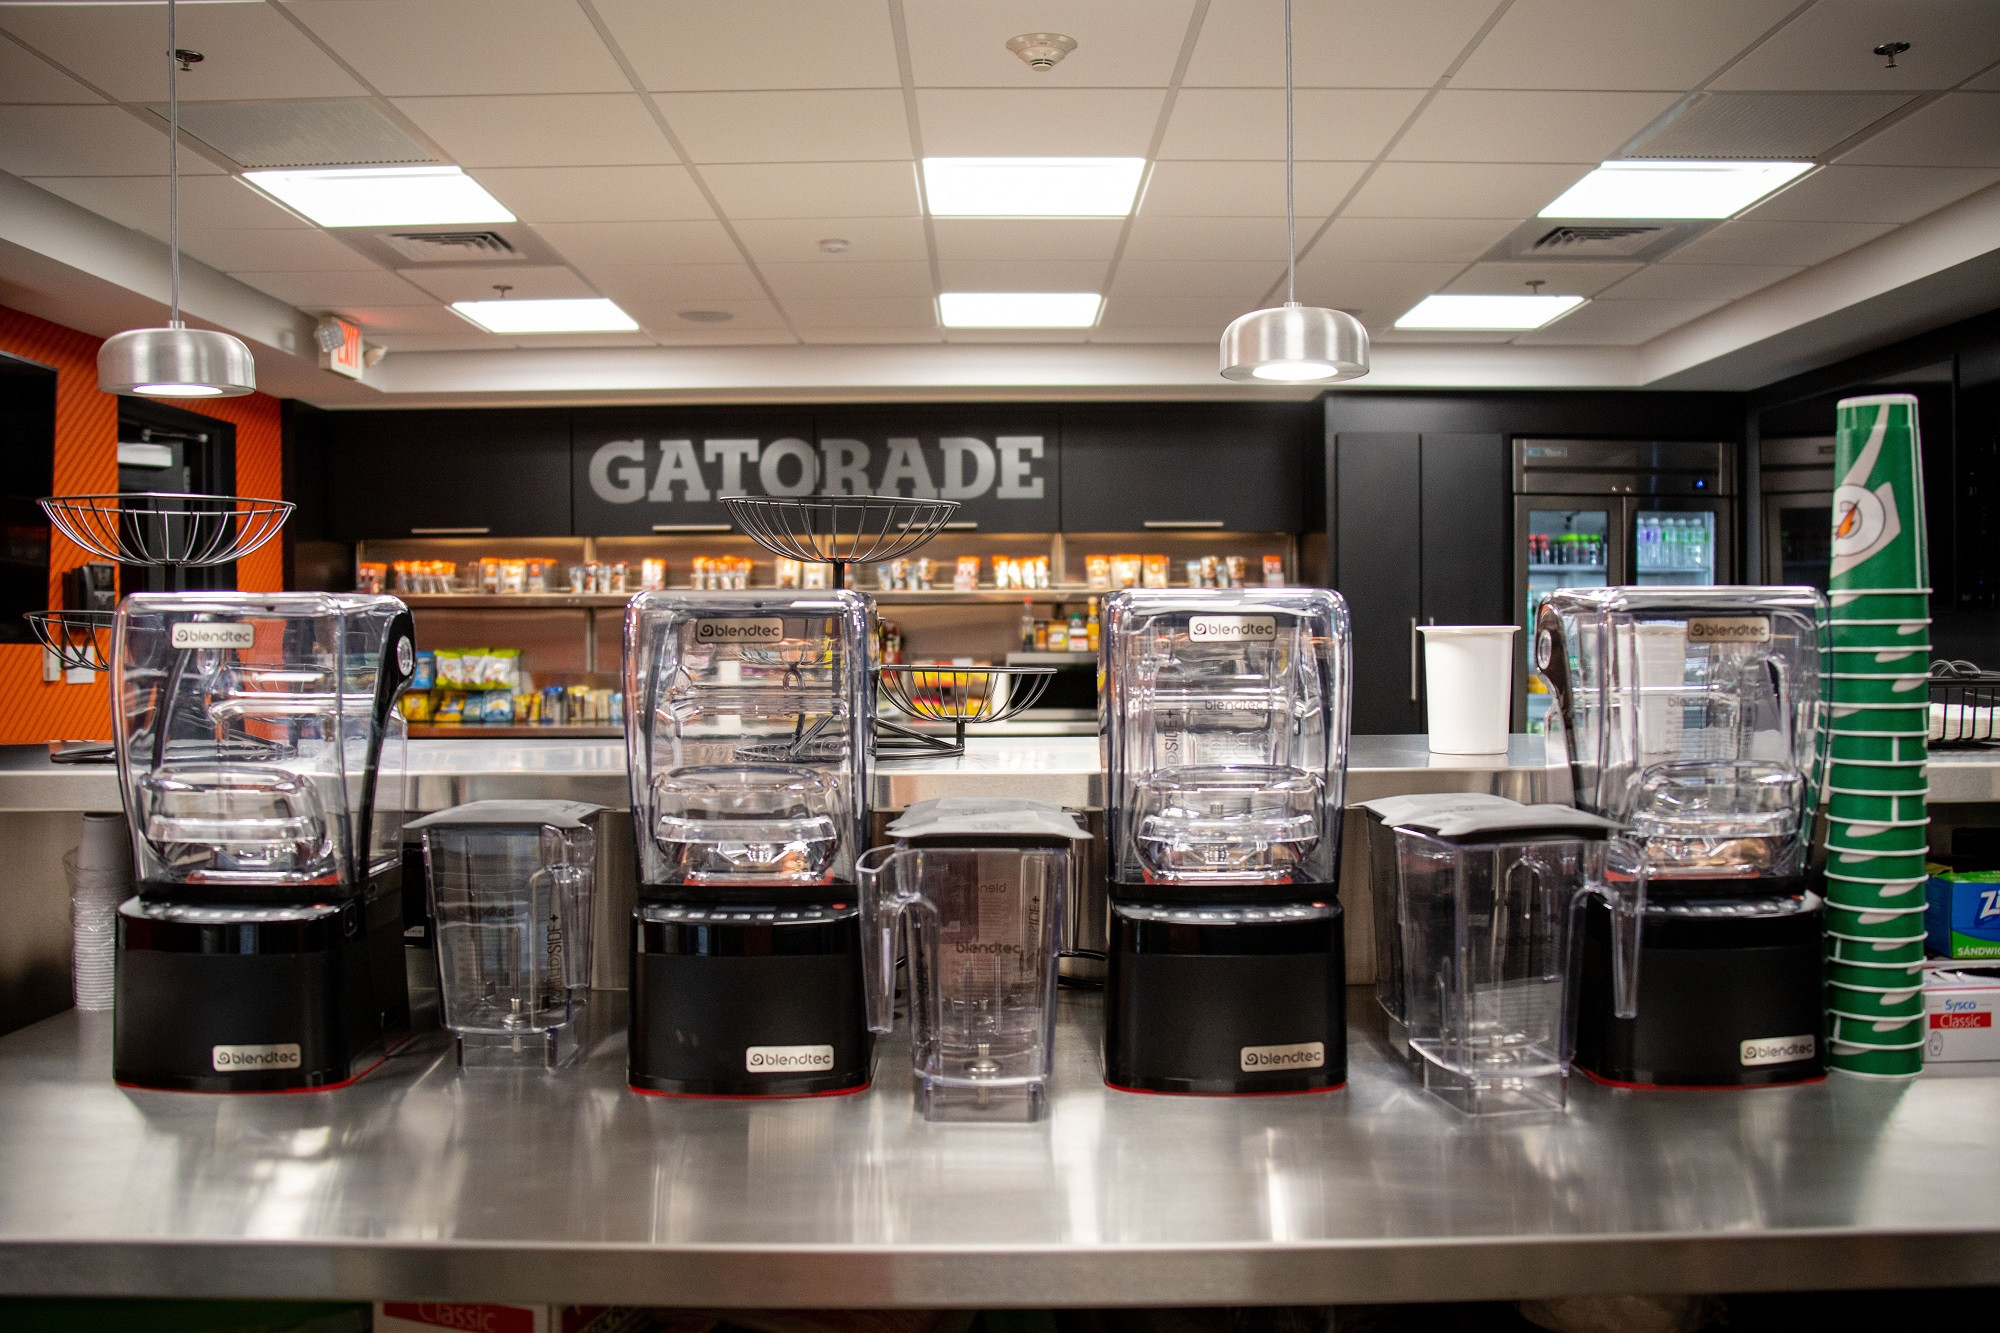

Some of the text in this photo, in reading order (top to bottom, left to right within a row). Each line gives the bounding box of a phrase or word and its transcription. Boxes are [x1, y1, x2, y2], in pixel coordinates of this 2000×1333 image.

[588, 436, 1045, 503] GATORADE
[715, 624, 780, 637] blendtec
[1208, 622, 1274, 635] blendtec
[1705, 624, 1766, 637] blendtec
[190, 630, 252, 643] blendtec
[955, 941, 1021, 955] blendtec
[1945, 999, 1977, 1012] Sysco
[1939, 1014, 1982, 1028] Classic
[1758, 1043, 1812, 1058] blendtec
[232, 1052, 298, 1065] blendtec
[765, 1053, 831, 1065] blendtec
[1260, 1051, 1321, 1065] blendtec
